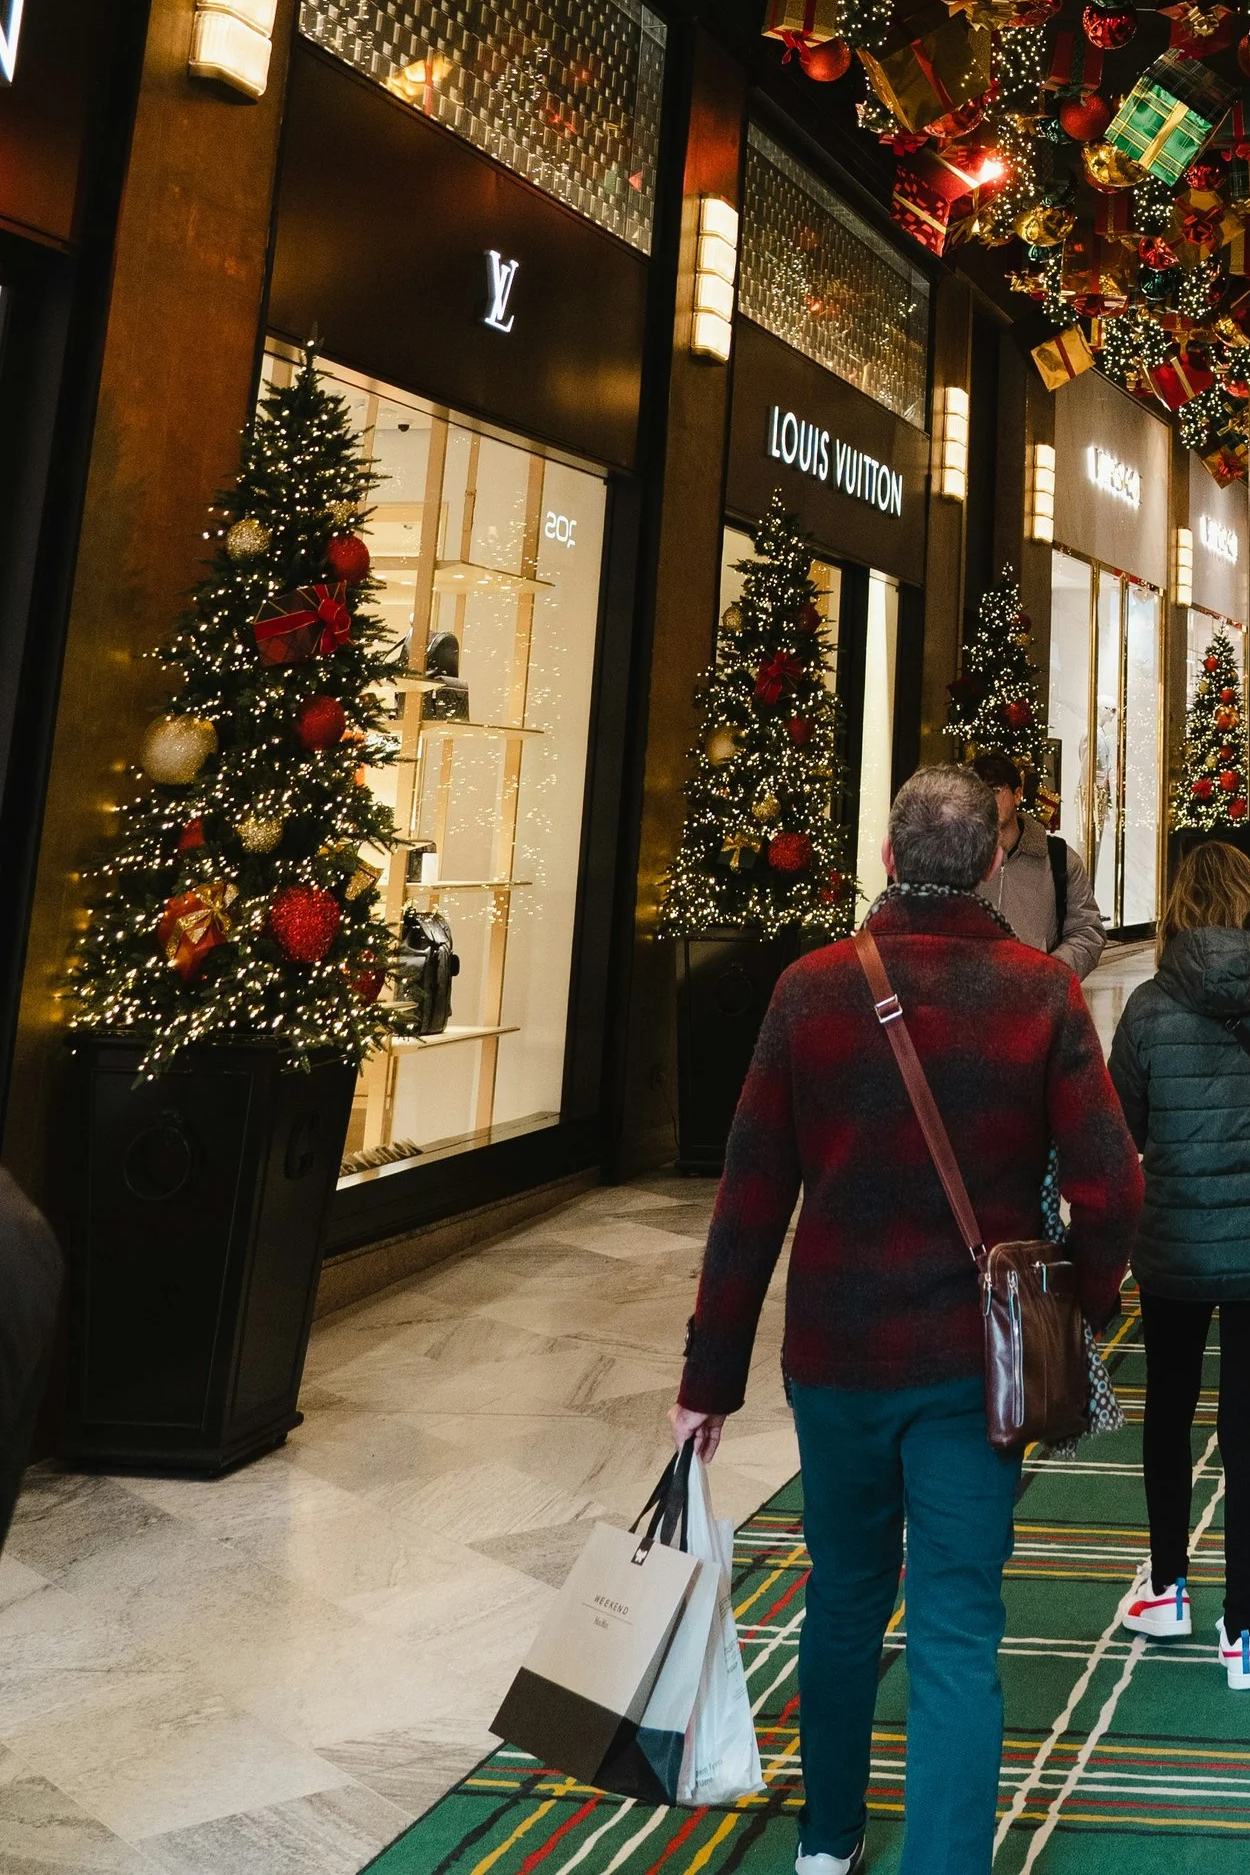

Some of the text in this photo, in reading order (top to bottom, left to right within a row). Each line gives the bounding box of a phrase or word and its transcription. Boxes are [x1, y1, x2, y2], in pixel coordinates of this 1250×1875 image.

[769, 405, 903, 517] LOUIS VUITTON
[594, 1595, 630, 1615] WEEKEND
